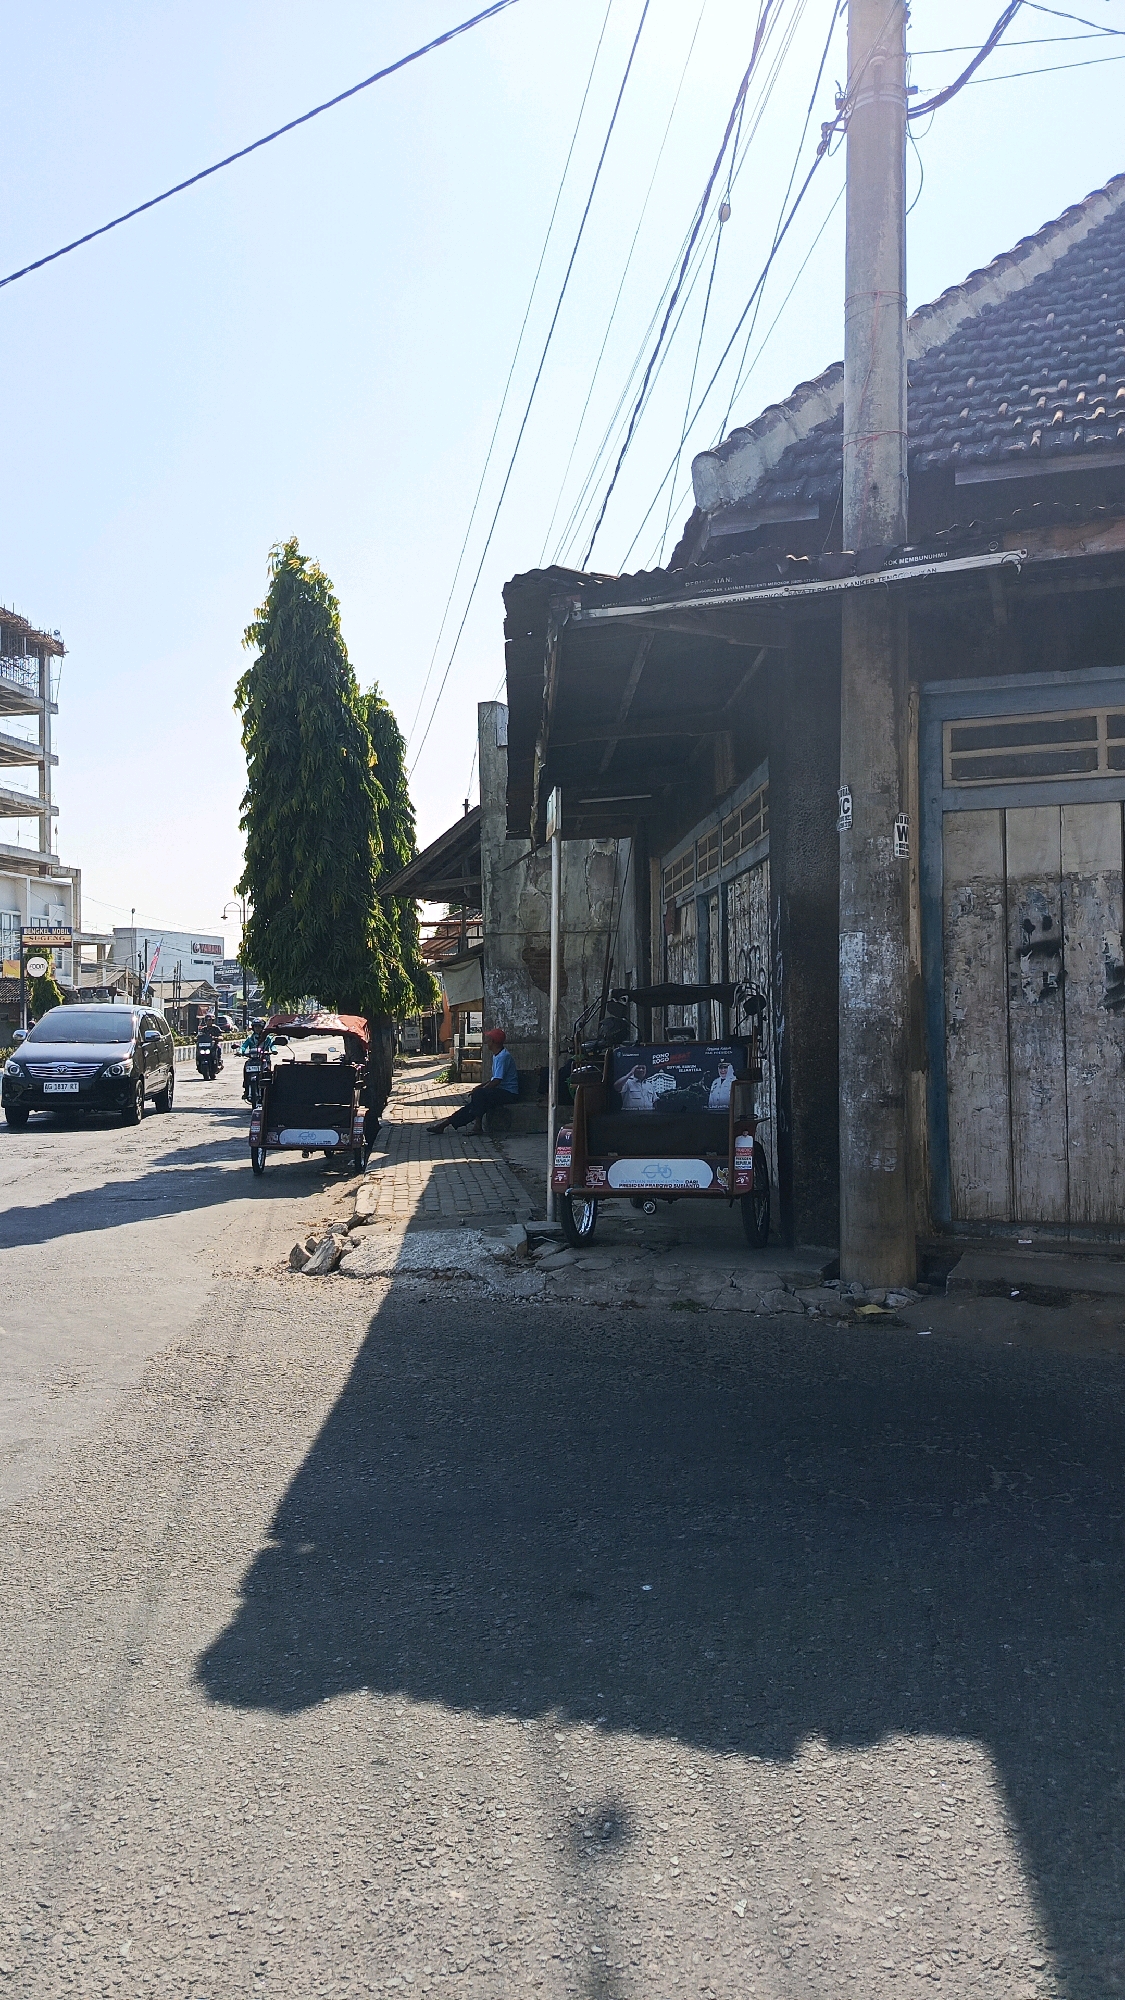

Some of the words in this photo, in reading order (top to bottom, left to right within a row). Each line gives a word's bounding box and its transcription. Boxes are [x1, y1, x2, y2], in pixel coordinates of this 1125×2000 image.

[23, 927, 51, 935] BENGKEL
[51, 927, 71, 935] MOBIL
[652, 1052, 670, 1060] PONO
[652, 1057, 670, 1065] ROGO
